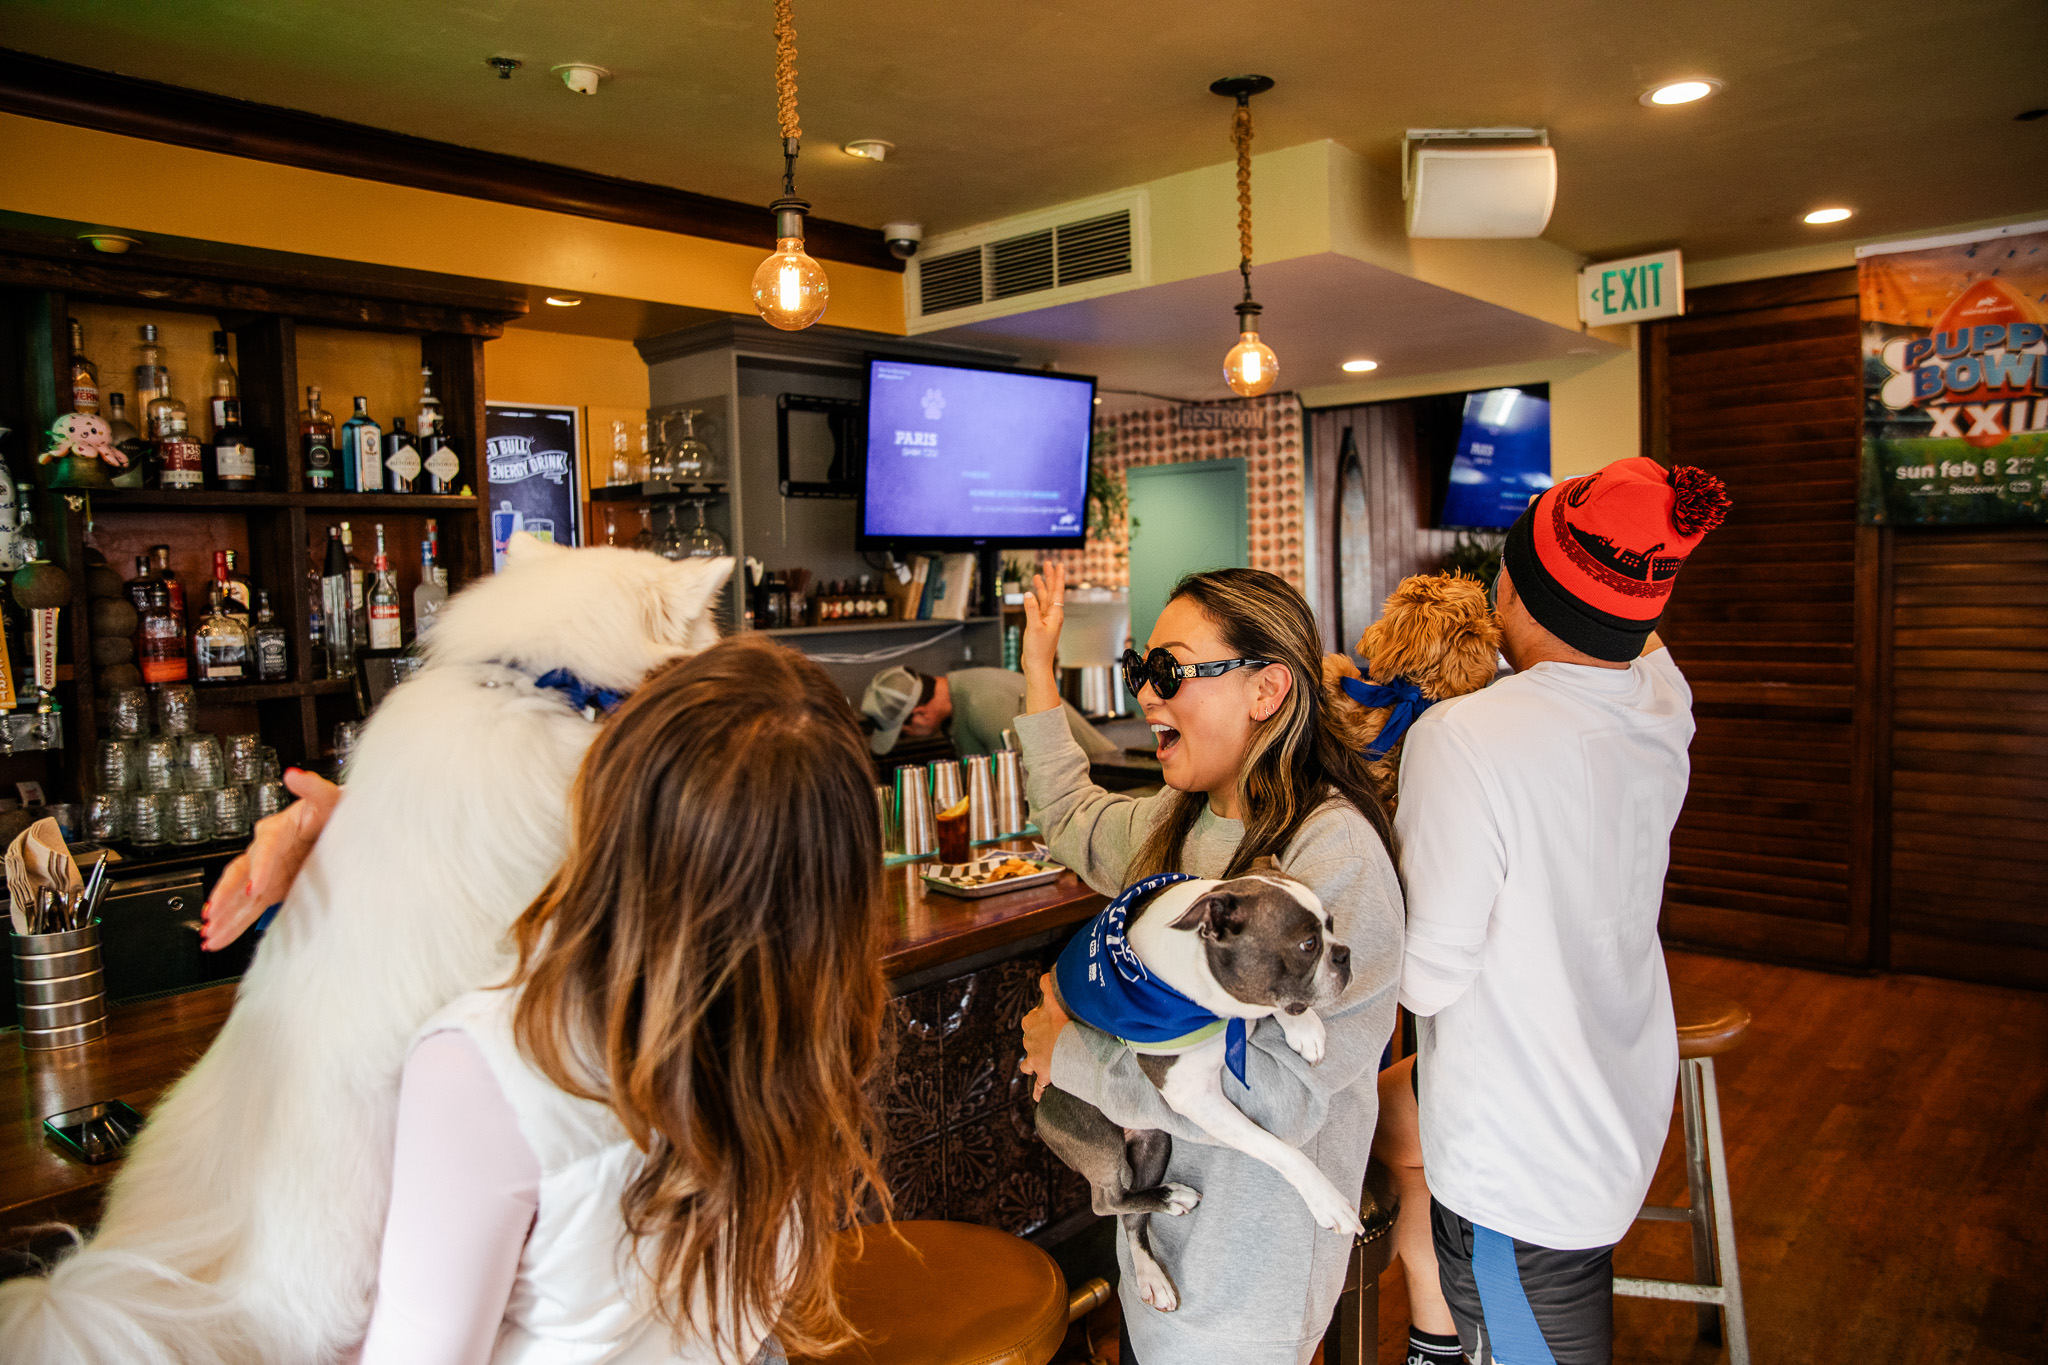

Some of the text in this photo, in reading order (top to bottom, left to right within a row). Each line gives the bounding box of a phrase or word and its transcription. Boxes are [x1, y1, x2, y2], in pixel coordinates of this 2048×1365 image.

[1602, 262, 1664, 315] EXIT
[1903, 323, 2048, 371] PUPP
[1181, 407, 1266, 430] RESTROOM
[499, 439, 528, 456] BULL
[895, 430, 938, 447] PARIS
[490, 454, 565, 480] ENERGY DRINK
[1895, 464, 1936, 480] sun
[1940, 460, 1978, 478] feb
[1982, 458, 1997, 476] 8
[2005, 457, 2020, 475] 2
[45, 650, 53, 685] ARTOIS
